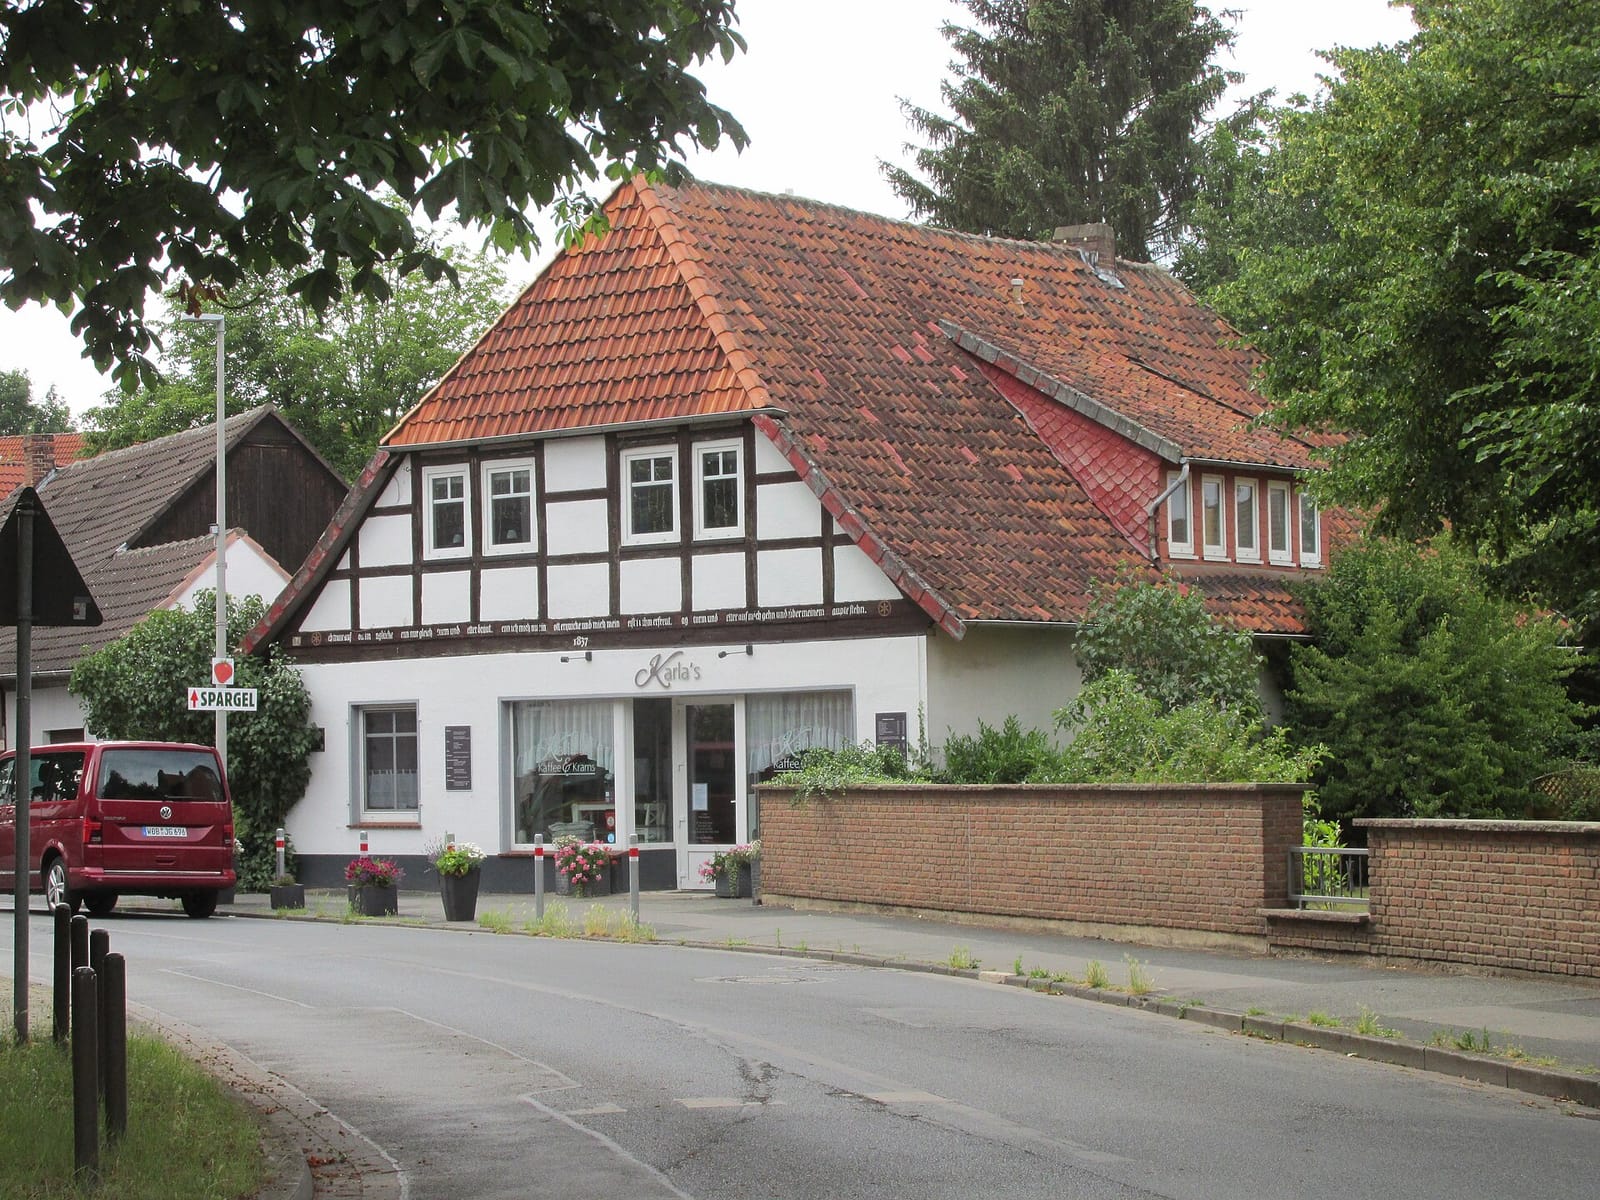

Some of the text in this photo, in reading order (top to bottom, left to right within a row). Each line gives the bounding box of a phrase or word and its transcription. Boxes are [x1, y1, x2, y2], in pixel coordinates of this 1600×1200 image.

[829, 606, 849, 616] aupte
[573, 636, 588, 647] 1837
[634, 650, 701, 688] Karla's
[200, 691, 255, 707] SPARGEL
[538, 761, 562, 773] Kaffee
[572, 762, 596, 773] Krams
